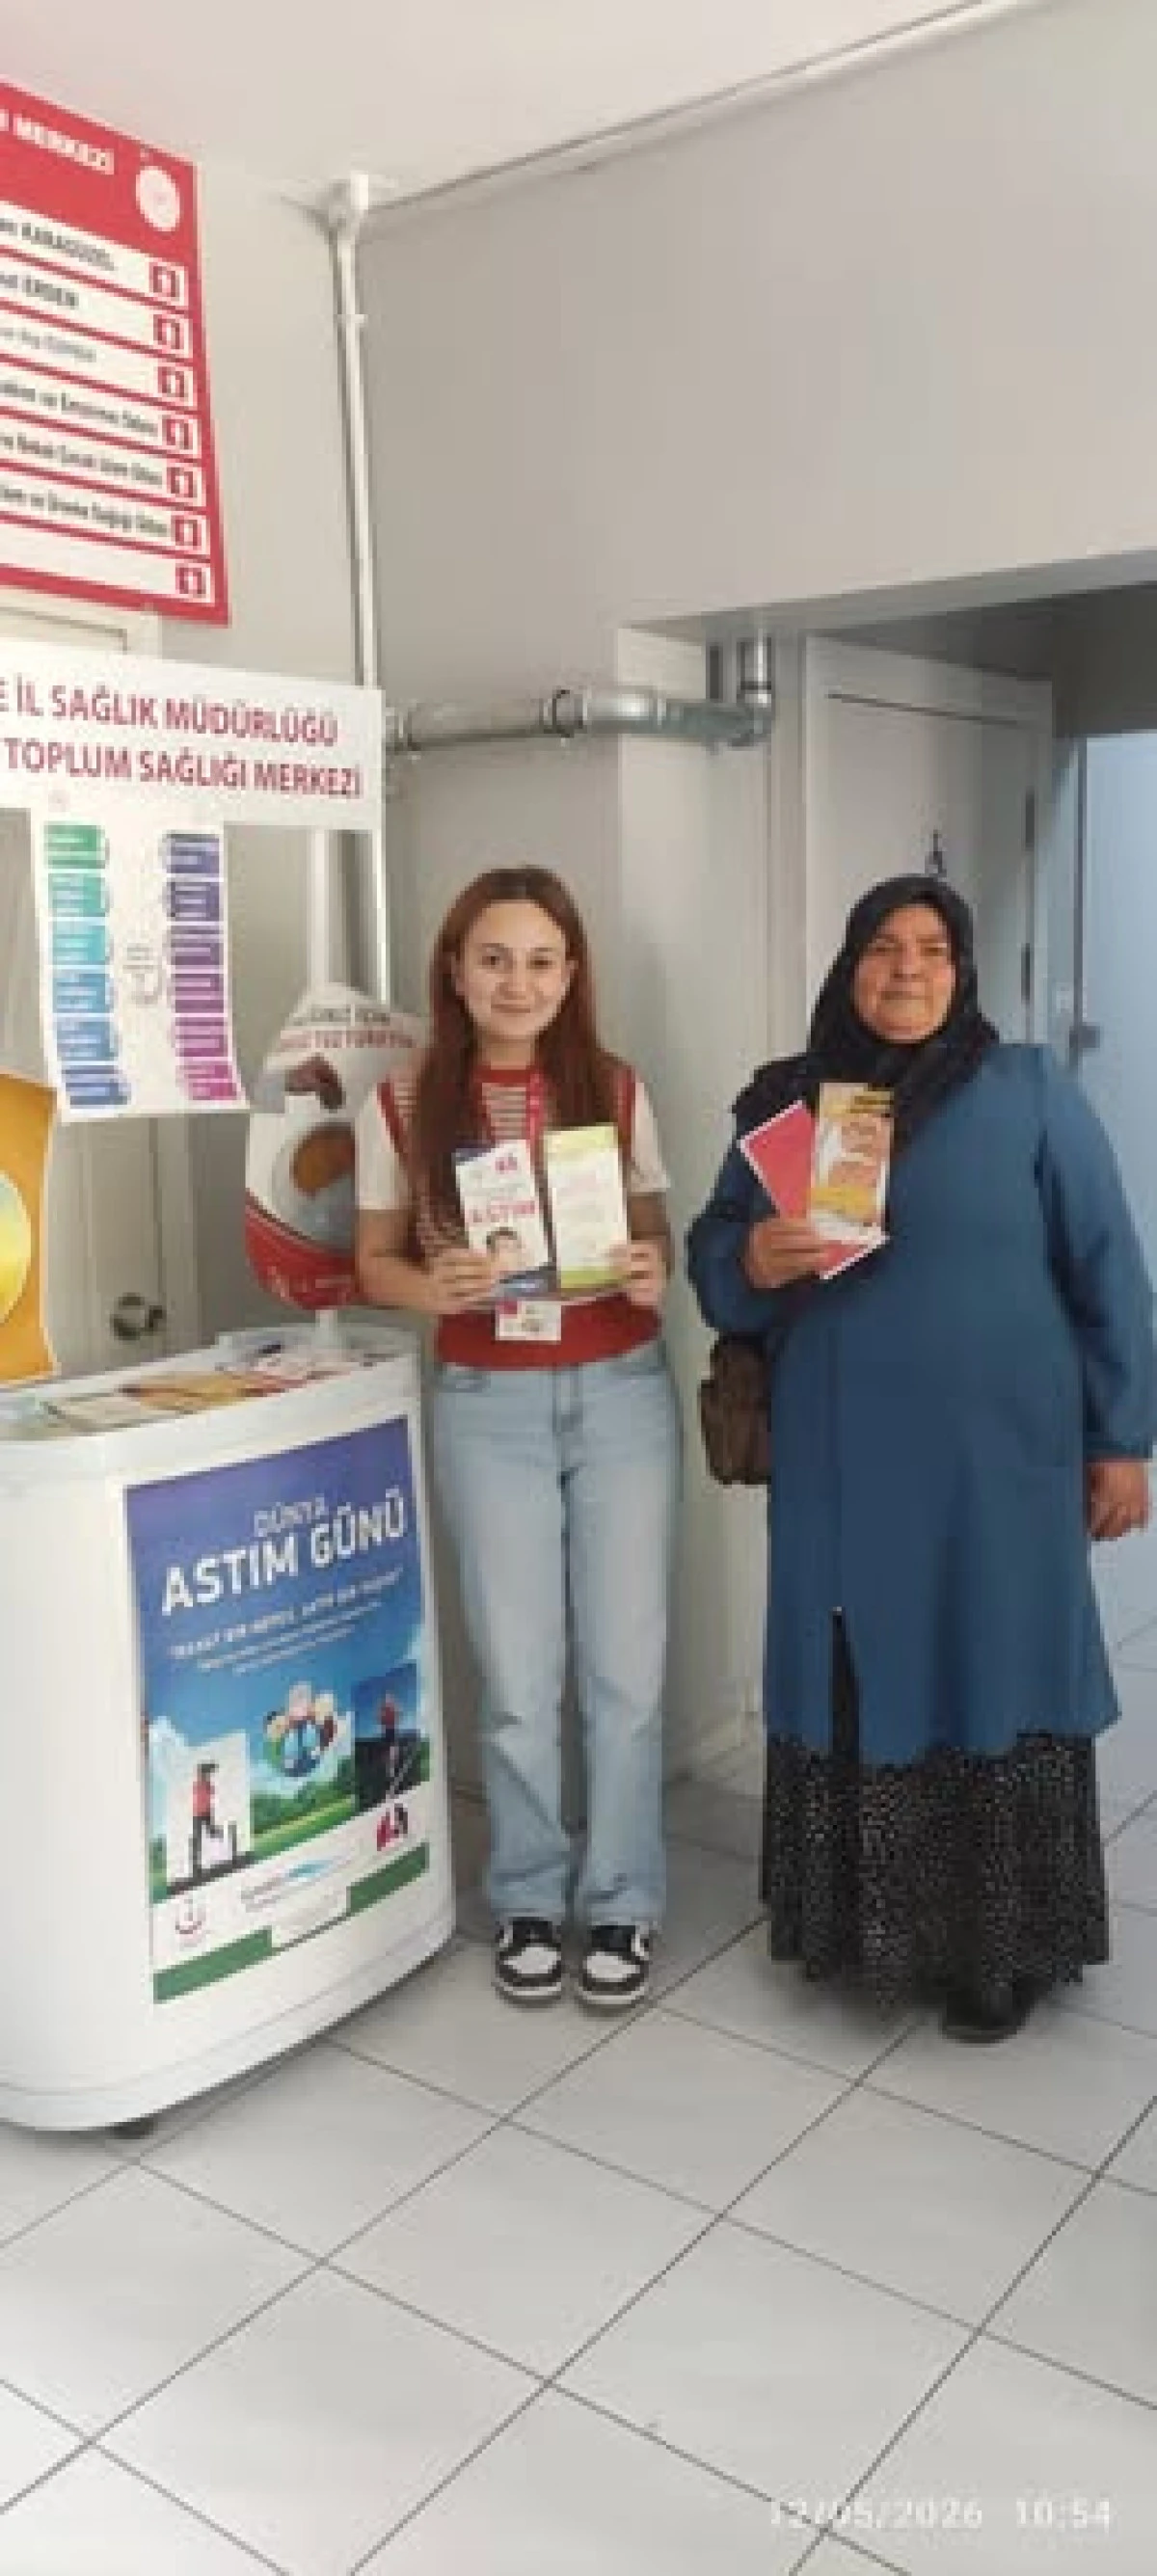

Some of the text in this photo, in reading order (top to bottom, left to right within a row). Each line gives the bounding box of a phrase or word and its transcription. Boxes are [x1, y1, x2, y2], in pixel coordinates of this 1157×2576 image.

[15, 673, 44, 716] İL
[51, 684, 158, 731] SAĞLIK
[166, 695, 339, 748] MÜDÜRLÜĞÜ
[5, 738, 362, 799] TOPLUM SAĞLIĞI MERKEZİ
[254, 1495, 327, 1538] DÜNYA
[161, 1485, 409, 1617] ASTIM GÜNÜ
